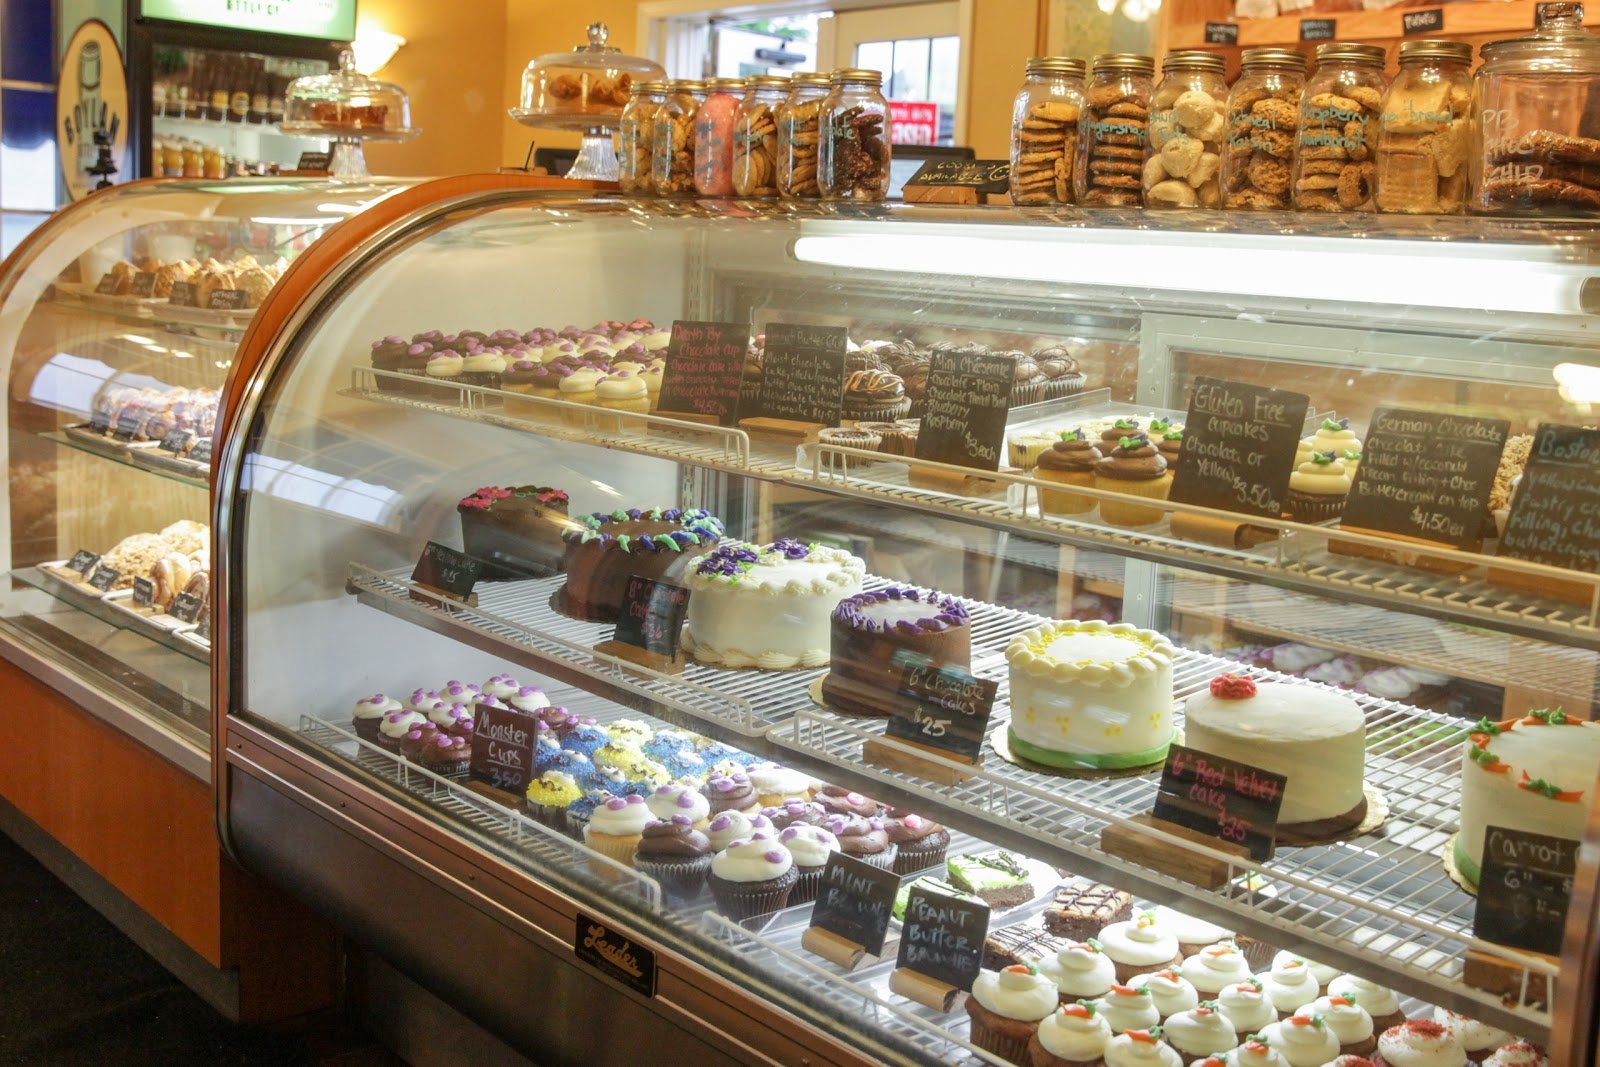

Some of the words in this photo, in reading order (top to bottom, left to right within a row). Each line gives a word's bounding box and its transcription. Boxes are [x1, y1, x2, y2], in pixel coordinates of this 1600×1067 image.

[1194, 384, 1244, 418] Gluten
[1253, 394, 1287, 422] Free
[1376, 413, 1433, 435] German
[1437, 419, 1501, 442] Chocolate
[475, 710, 529, 748] Monster
[487, 740, 522, 767] Cups
[1194, 759, 1227, 788] Red
[1489, 830, 1567, 867] Carrot
[830, 864, 881, 896] MINT
[911, 895, 976, 929] PEANUT
